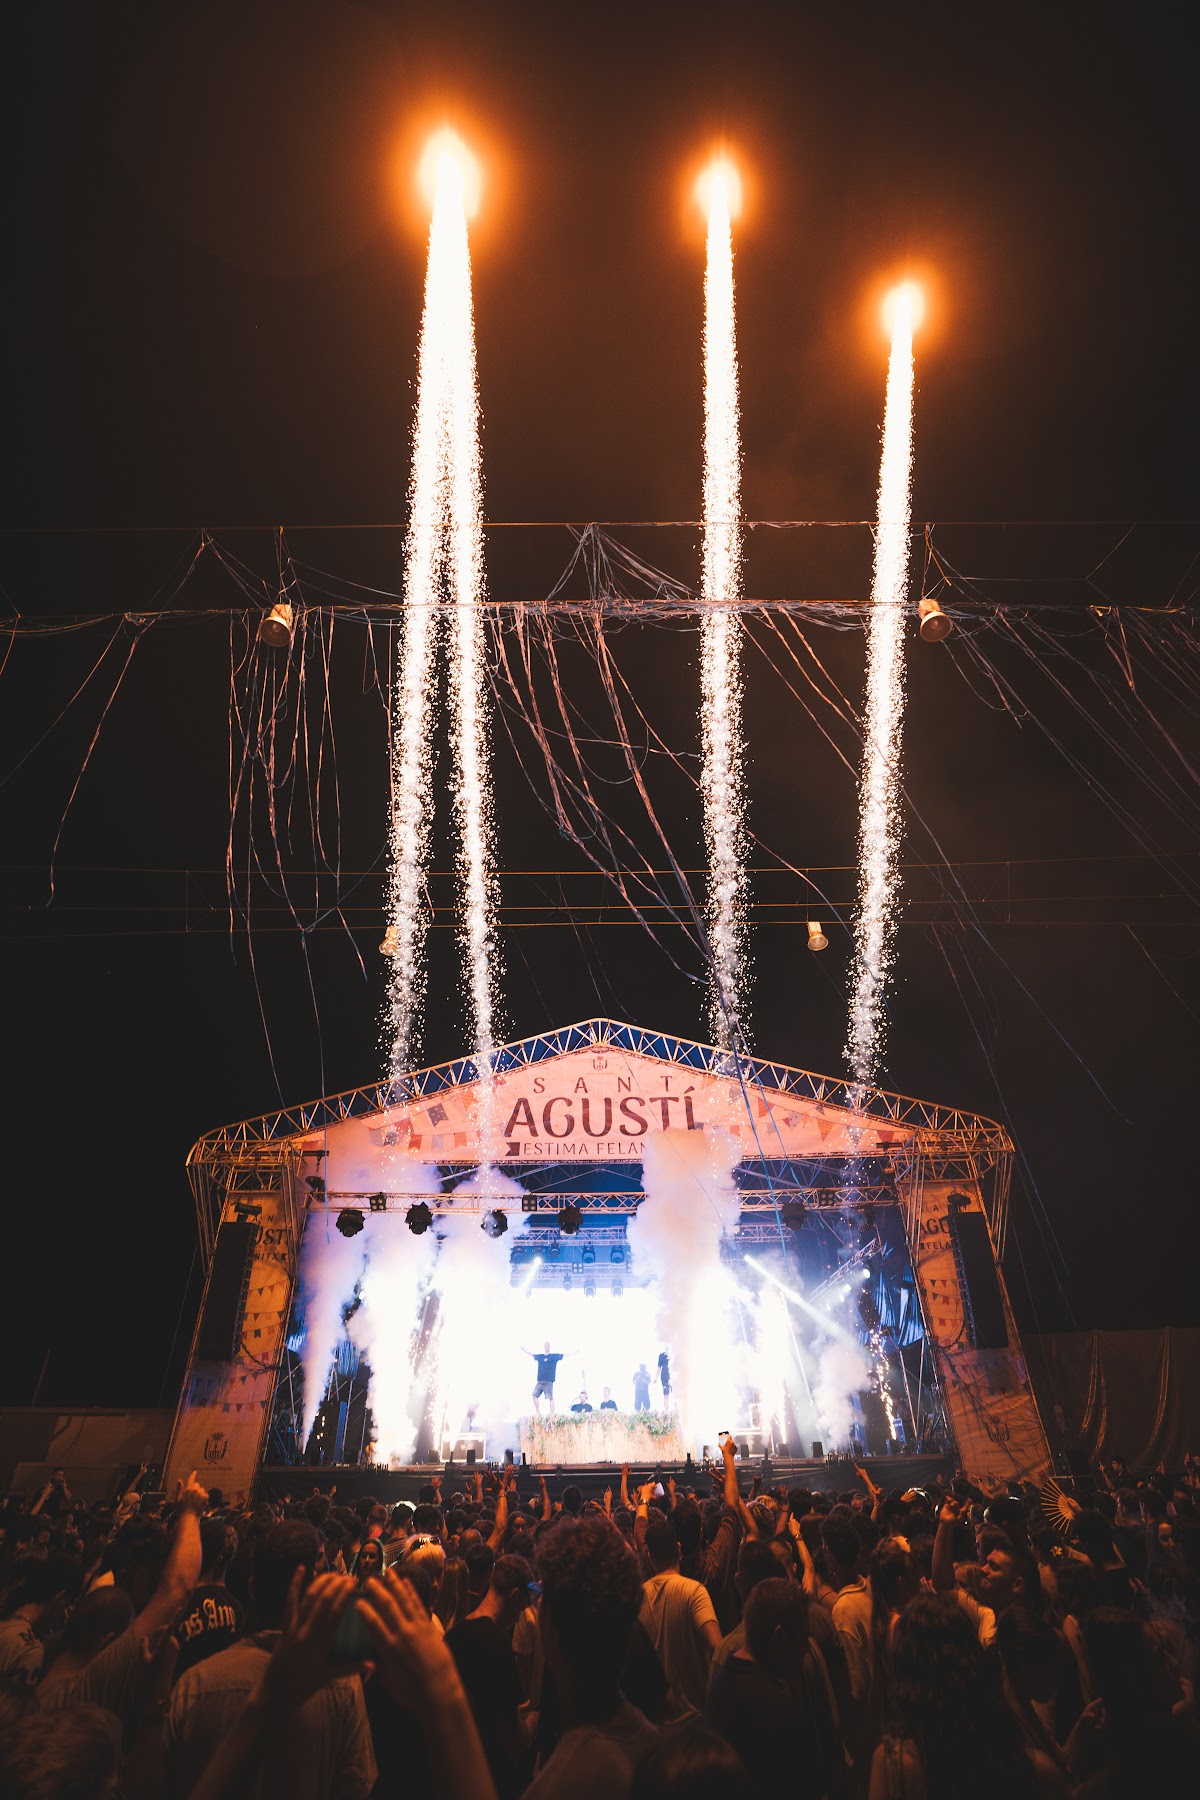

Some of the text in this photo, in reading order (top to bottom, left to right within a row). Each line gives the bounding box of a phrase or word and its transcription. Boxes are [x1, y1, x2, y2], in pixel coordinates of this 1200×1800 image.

[504, 1085, 696, 1138] AGUSTÍ
[523, 1142, 589, 1155] ESTIMA
[916, 1218, 951, 1235] AGU
[926, 1241, 952, 1250] FELA
[254, 1252, 279, 1260] NITX
